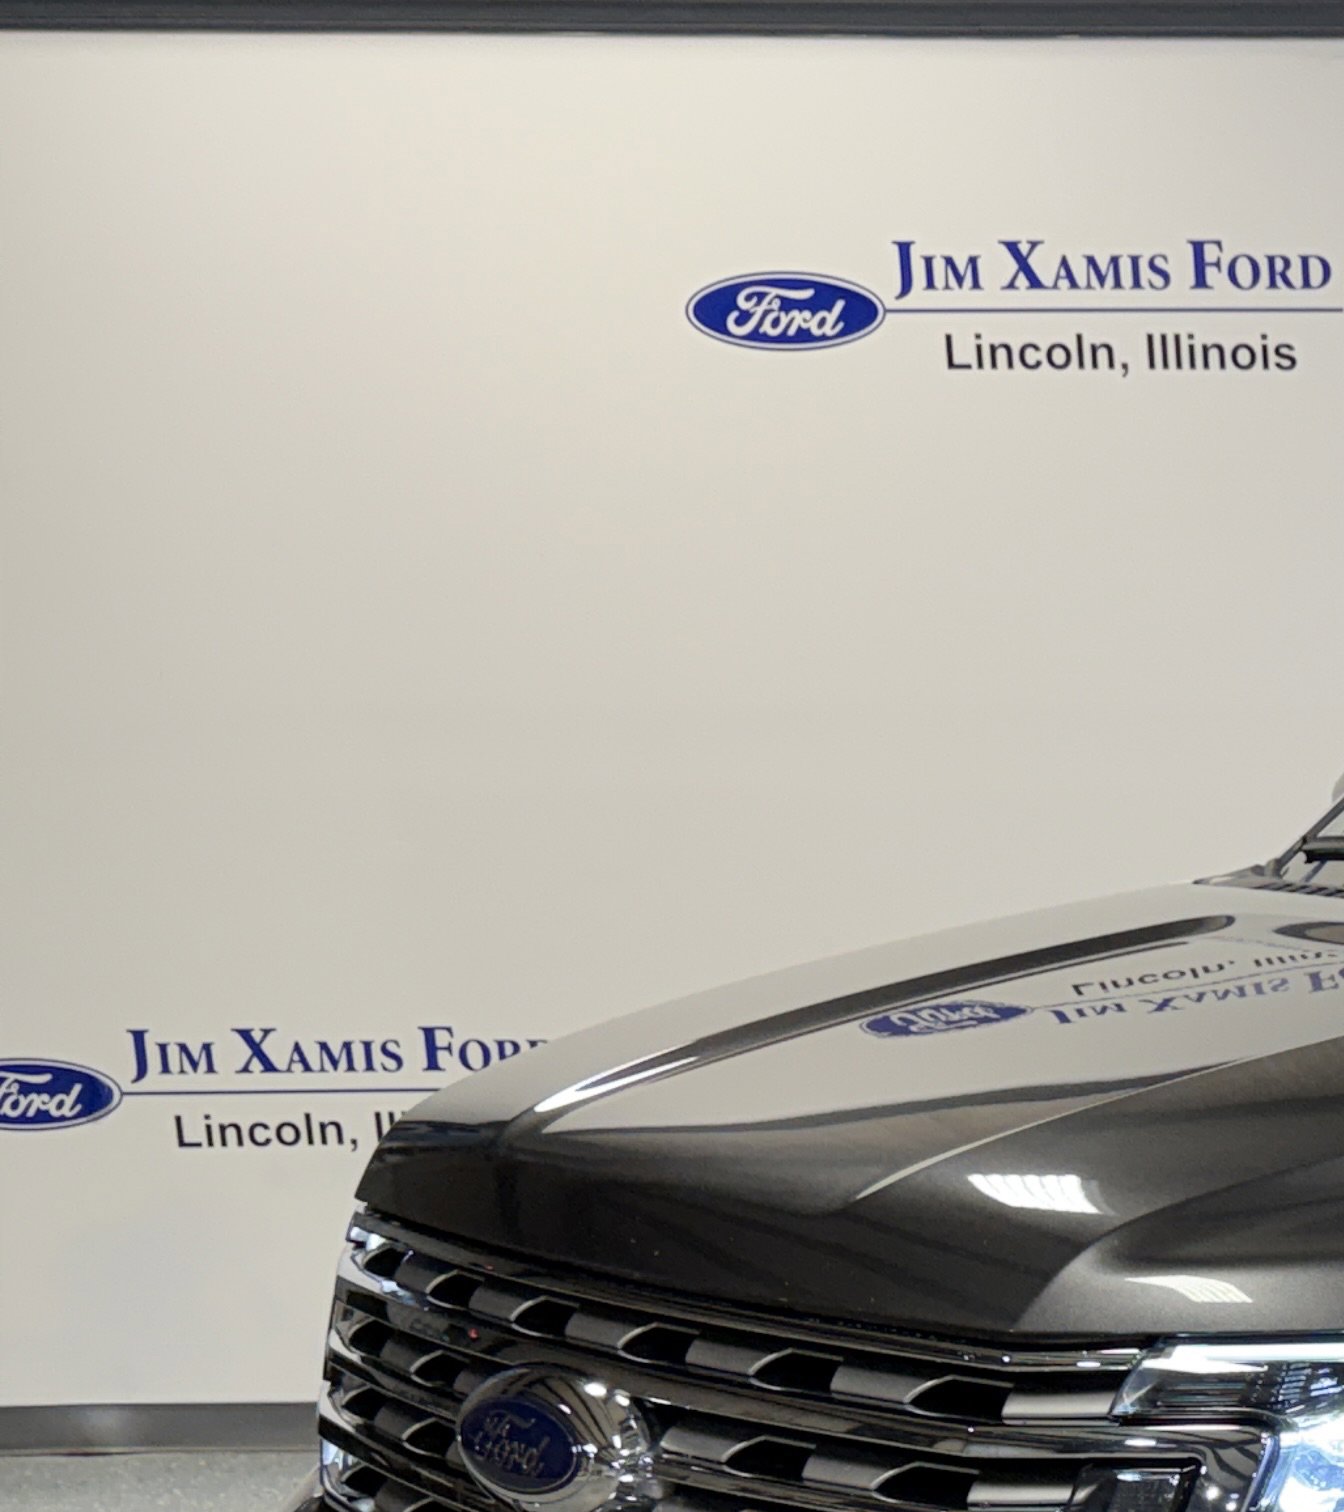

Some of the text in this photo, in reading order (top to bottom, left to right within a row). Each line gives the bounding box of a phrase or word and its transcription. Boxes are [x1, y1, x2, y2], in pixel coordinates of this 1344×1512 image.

[891, 240, 1332, 300] JIM XAMIS FORD
[726, 286, 846, 337] Ford
[945, 333, 1297, 378] Lincoln, Illinois
[126, 1026, 547, 1084] JIM XAMIS FOR
[174, 1112, 358, 1152] Lincoln,
[469, 1409, 547, 1479] Ford
